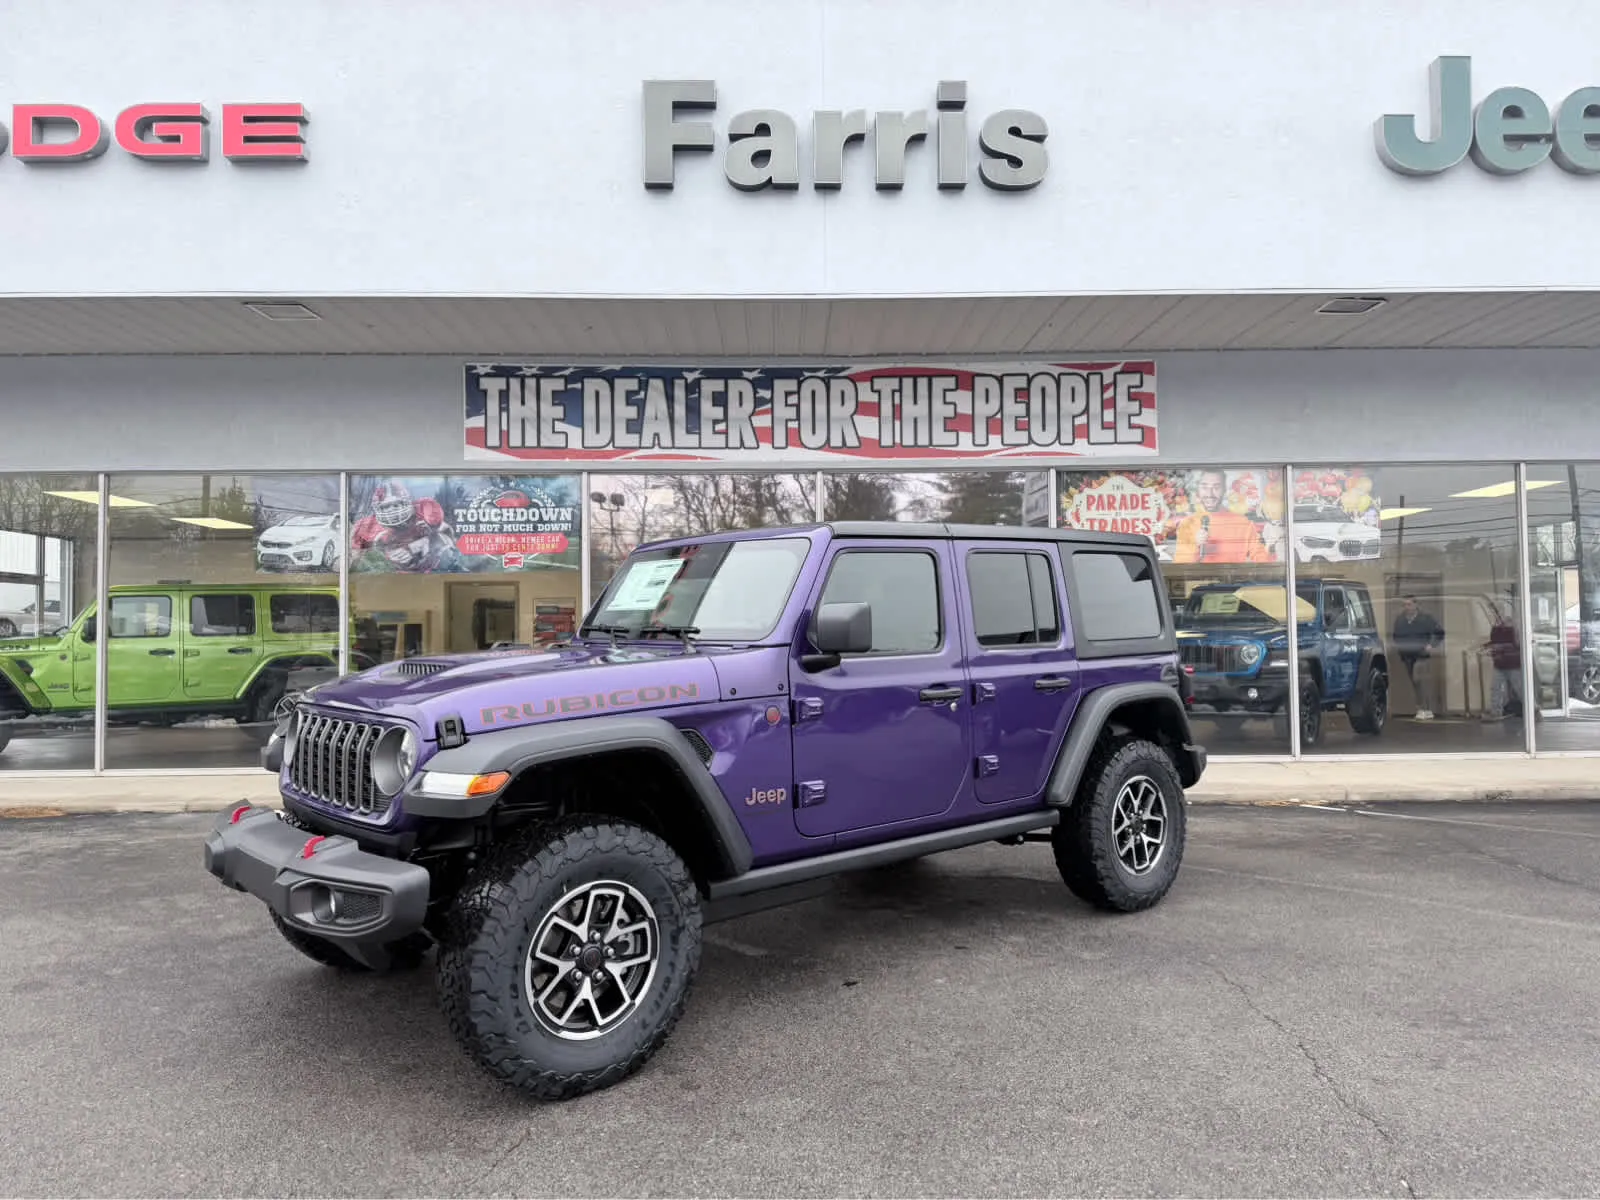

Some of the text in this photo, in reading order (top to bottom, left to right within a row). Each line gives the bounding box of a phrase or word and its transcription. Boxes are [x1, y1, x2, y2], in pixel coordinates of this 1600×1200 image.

[0, 101, 309, 164] DGE
[642, 80, 1049, 193] Farris
[480, 371, 1144, 450] THE DEALER FOR THE PEOPLE
[1087, 493, 1151, 511] PARADE
[454, 508, 573, 522] TOUCHDOWN
[456, 523, 572, 532] FOR NOT MUCH DOWN!
[1085, 518, 1152, 534] TRADES
[480, 682, 700, 725] RUBICON
[745, 787, 787, 806] Jeep
